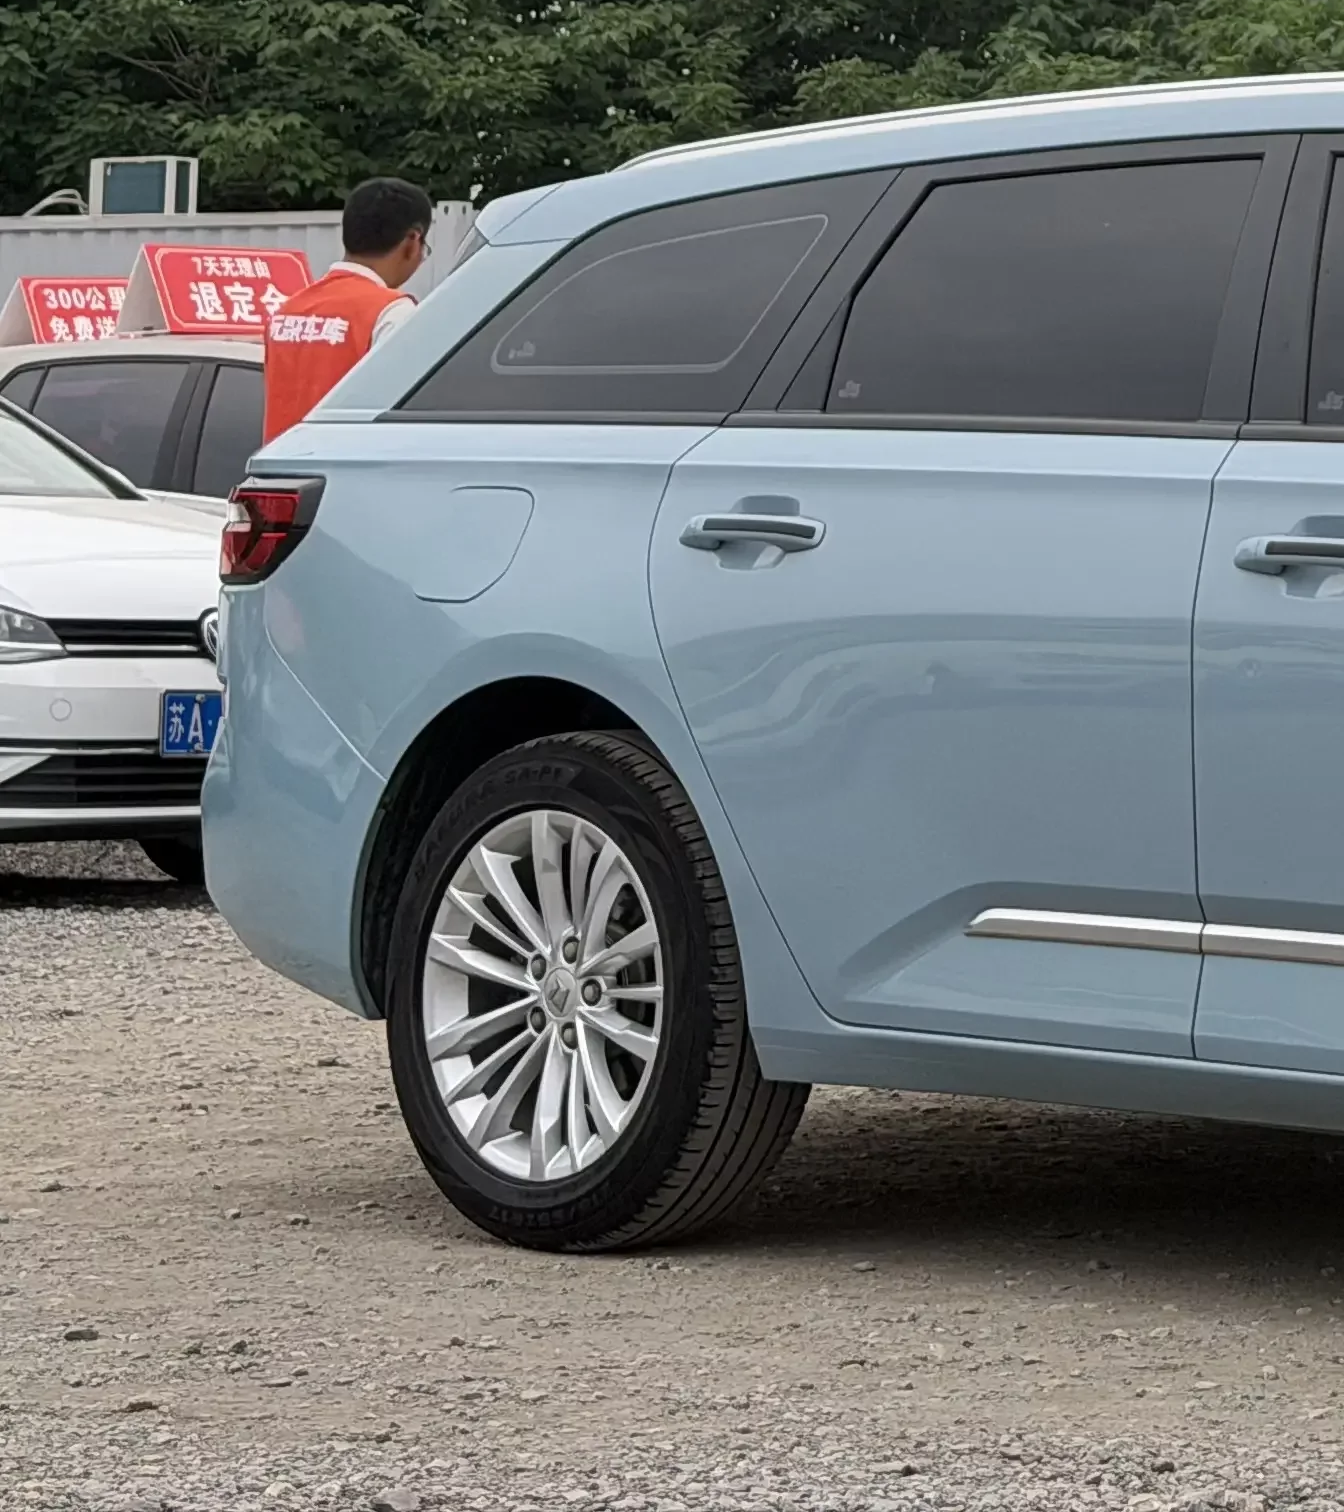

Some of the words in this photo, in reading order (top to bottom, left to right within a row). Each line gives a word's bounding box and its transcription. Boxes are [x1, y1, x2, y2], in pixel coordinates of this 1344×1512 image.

[191, 255, 272, 279] 7天无理由
[42, 285, 127, 311] 300公里
